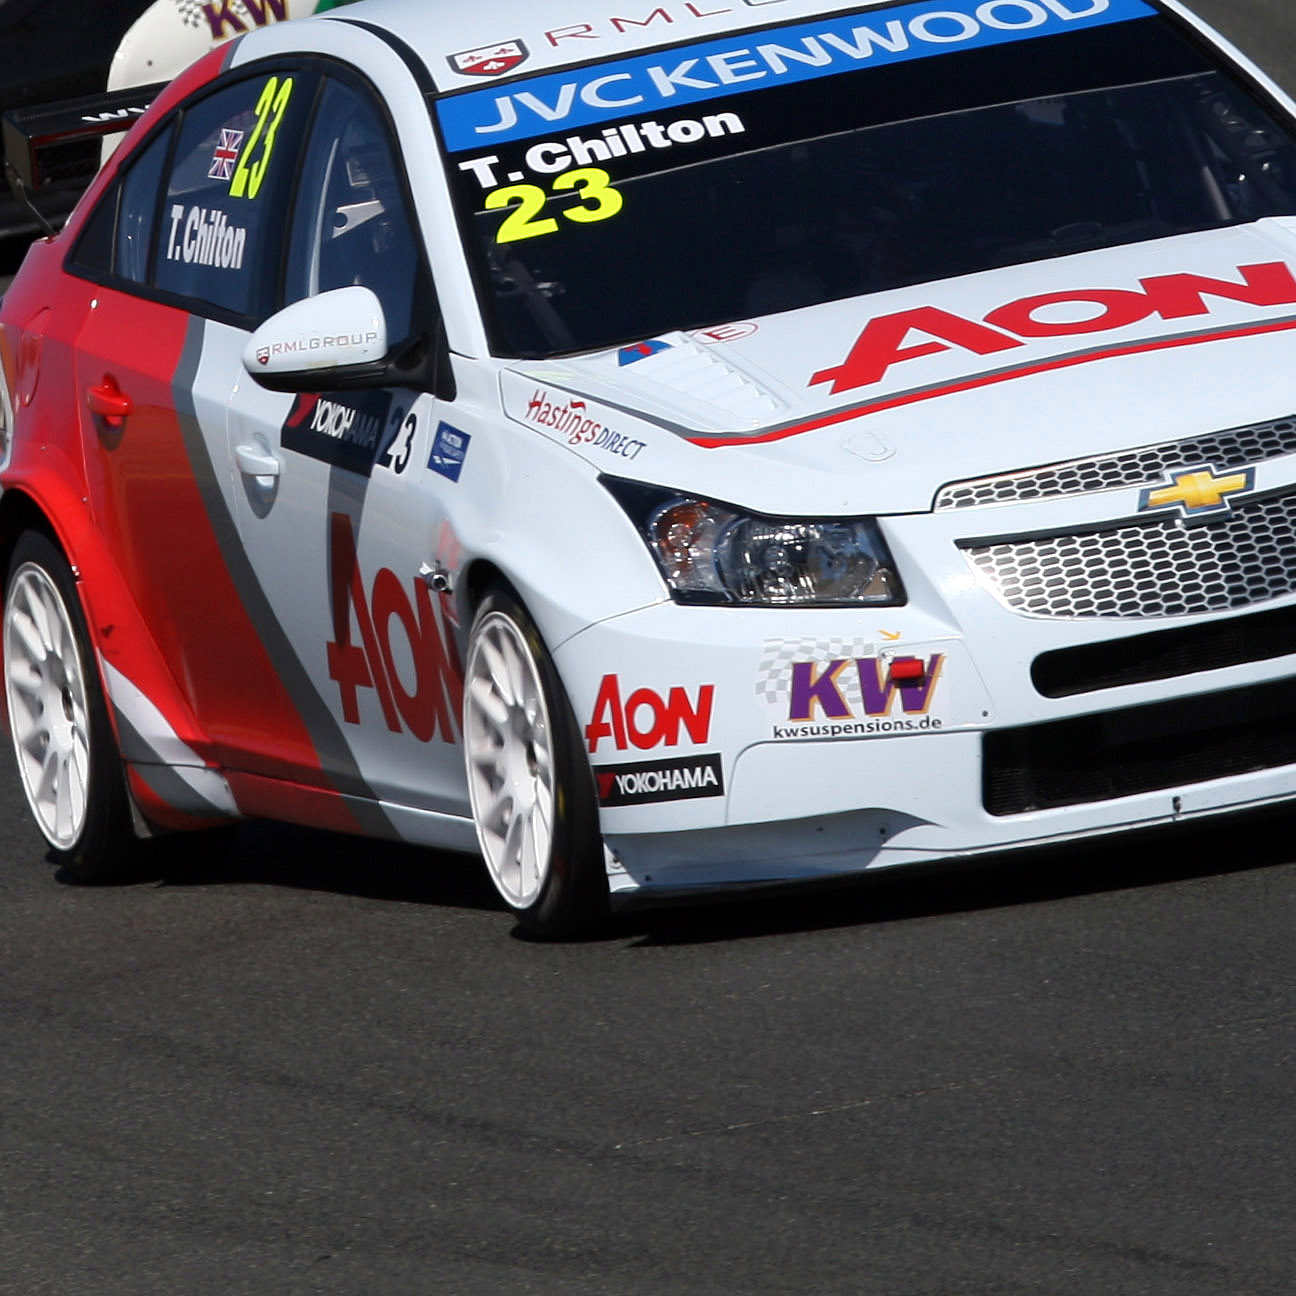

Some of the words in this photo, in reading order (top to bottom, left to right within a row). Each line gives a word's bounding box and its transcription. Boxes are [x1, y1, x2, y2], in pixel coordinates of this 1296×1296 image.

[229, 76, 294, 200] 23
[483, 167, 624, 246] 23
[309, 397, 381, 452] YOKOHAMA
[376, 406, 417, 475] 23
[789, 653, 947, 722] KW
[772, 714, 943, 741] kwsuspensions.de
[615, 764, 719, 797] YOKOHAMA
